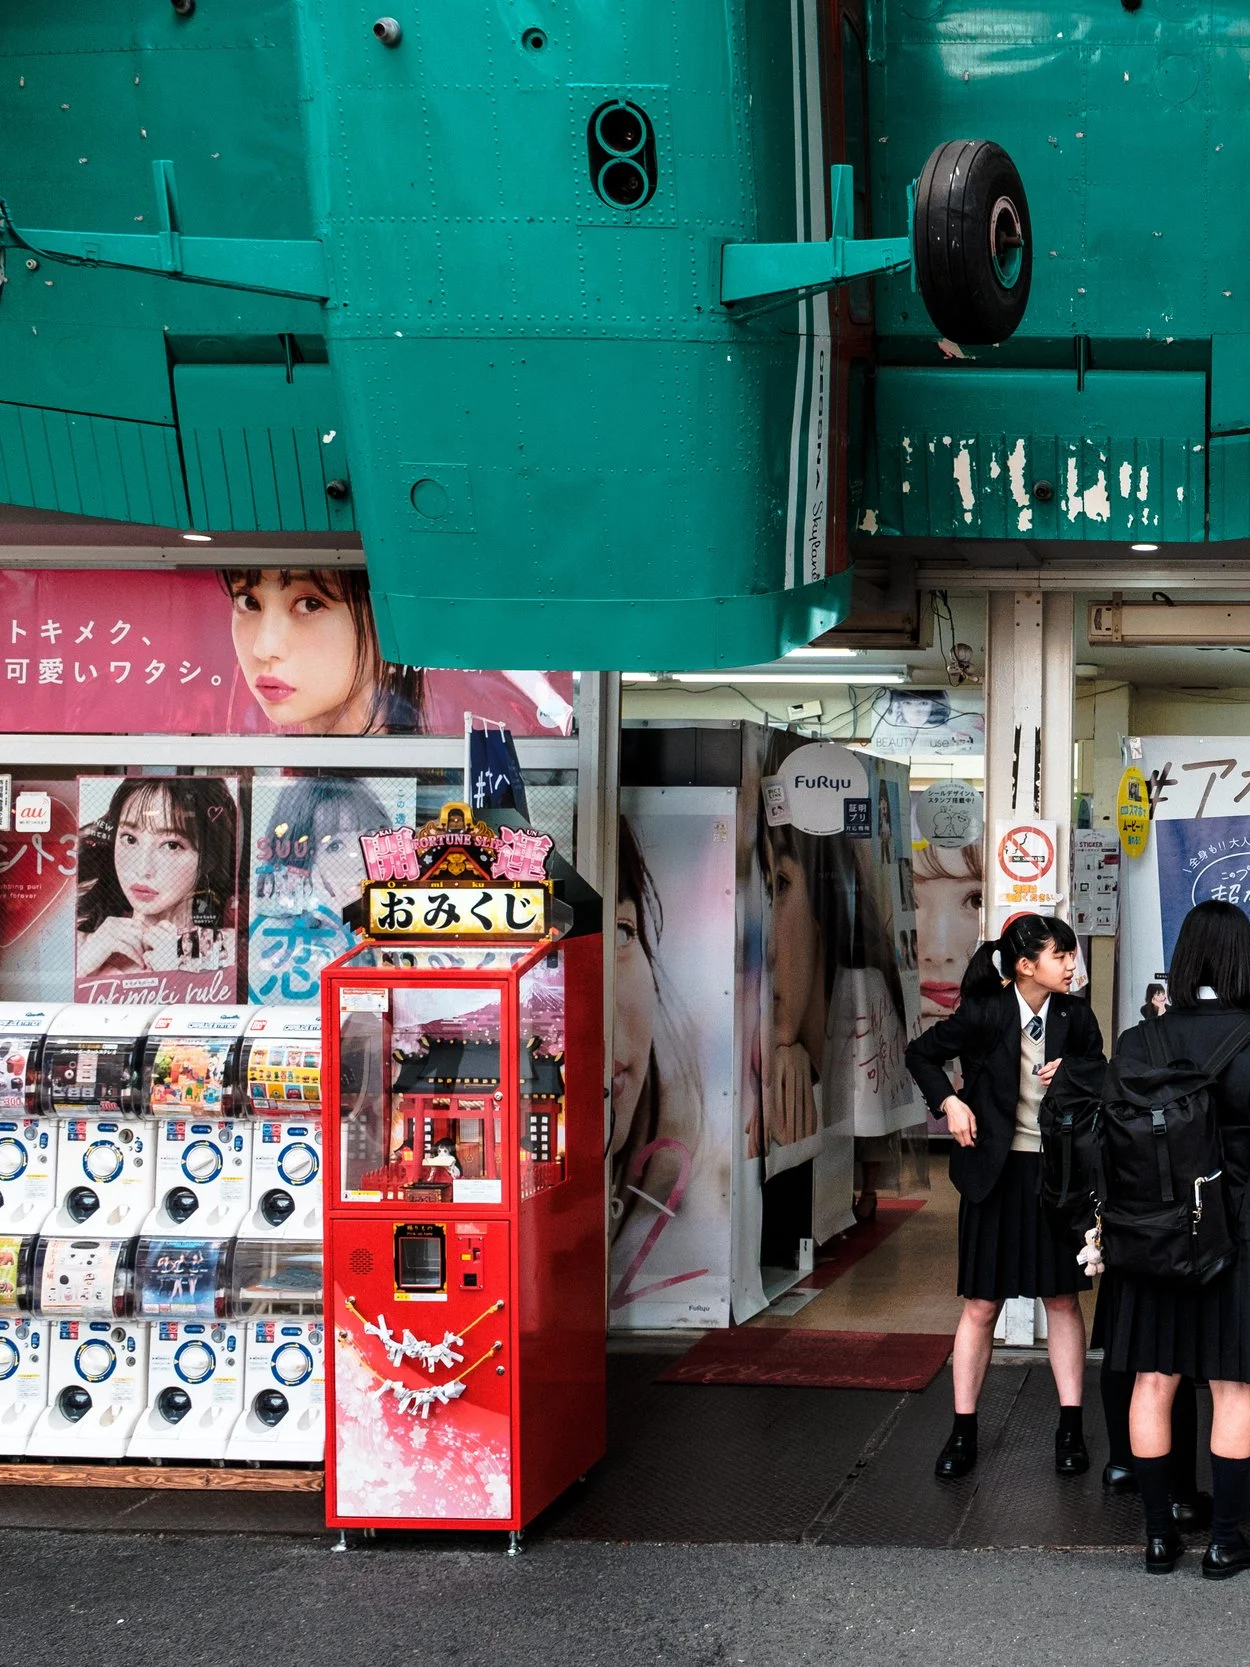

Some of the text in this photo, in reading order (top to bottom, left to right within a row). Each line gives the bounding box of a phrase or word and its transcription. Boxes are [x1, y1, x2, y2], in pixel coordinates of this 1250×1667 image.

[8, 619, 155, 646] トキメク、
[4, 657, 222, 686] 可愛いワタシ。
[875, 736, 916, 748] BEAUTY
[794, 775, 852, 793] FuRyu
[20, 807, 47, 818] au
[848, 803, 867, 813] 証明
[848, 813, 867, 823] プリ
[378, 828, 393, 837] KAI
[526, 829, 538, 837] UN
[410, 833, 504, 851] FORTUNE SLIP
[1078, 841, 1104, 849] STICKER
[430, 881, 444, 889] mi
[471, 881, 485, 889] ku
[377, 890, 537, 932] おみくじ
